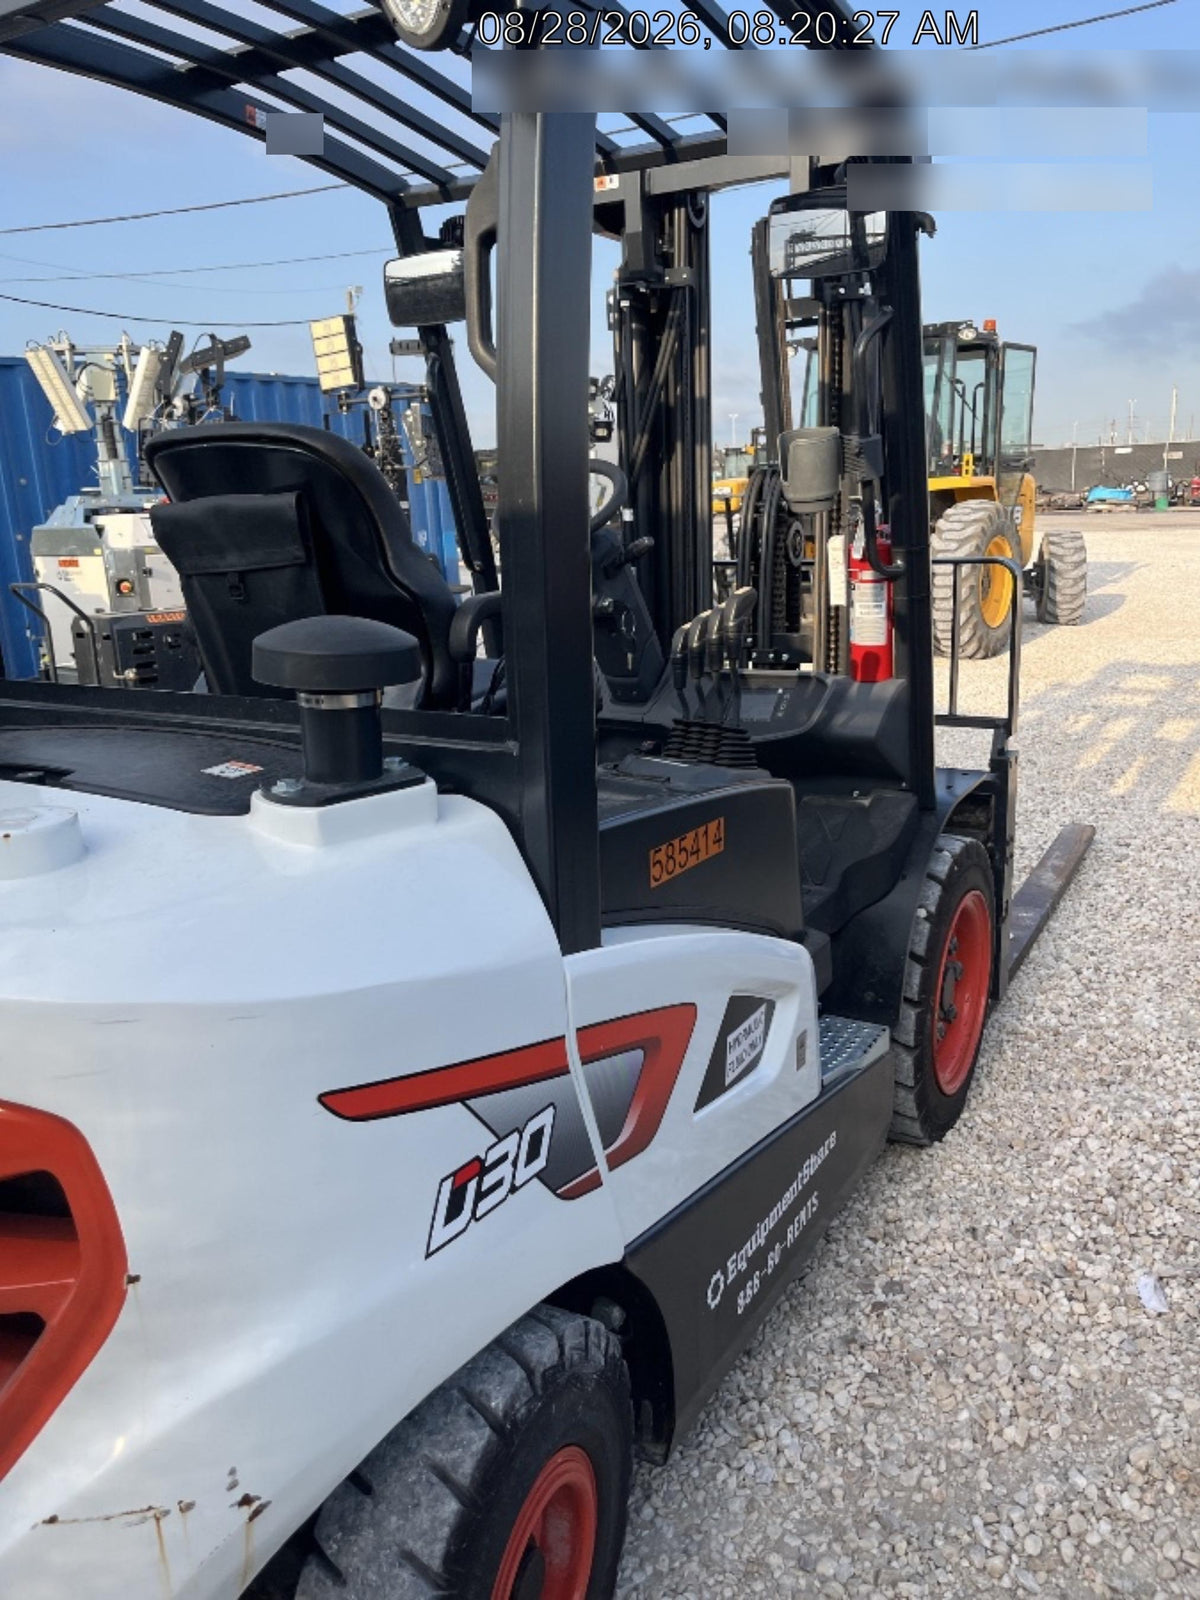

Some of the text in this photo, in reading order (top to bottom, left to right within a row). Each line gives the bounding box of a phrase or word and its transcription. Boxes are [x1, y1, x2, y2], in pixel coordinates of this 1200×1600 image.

[651, 819, 723, 883] 585414
[425, 1102, 557, 1261] D30
[726, 1130, 837, 1285] EquipmentShare
